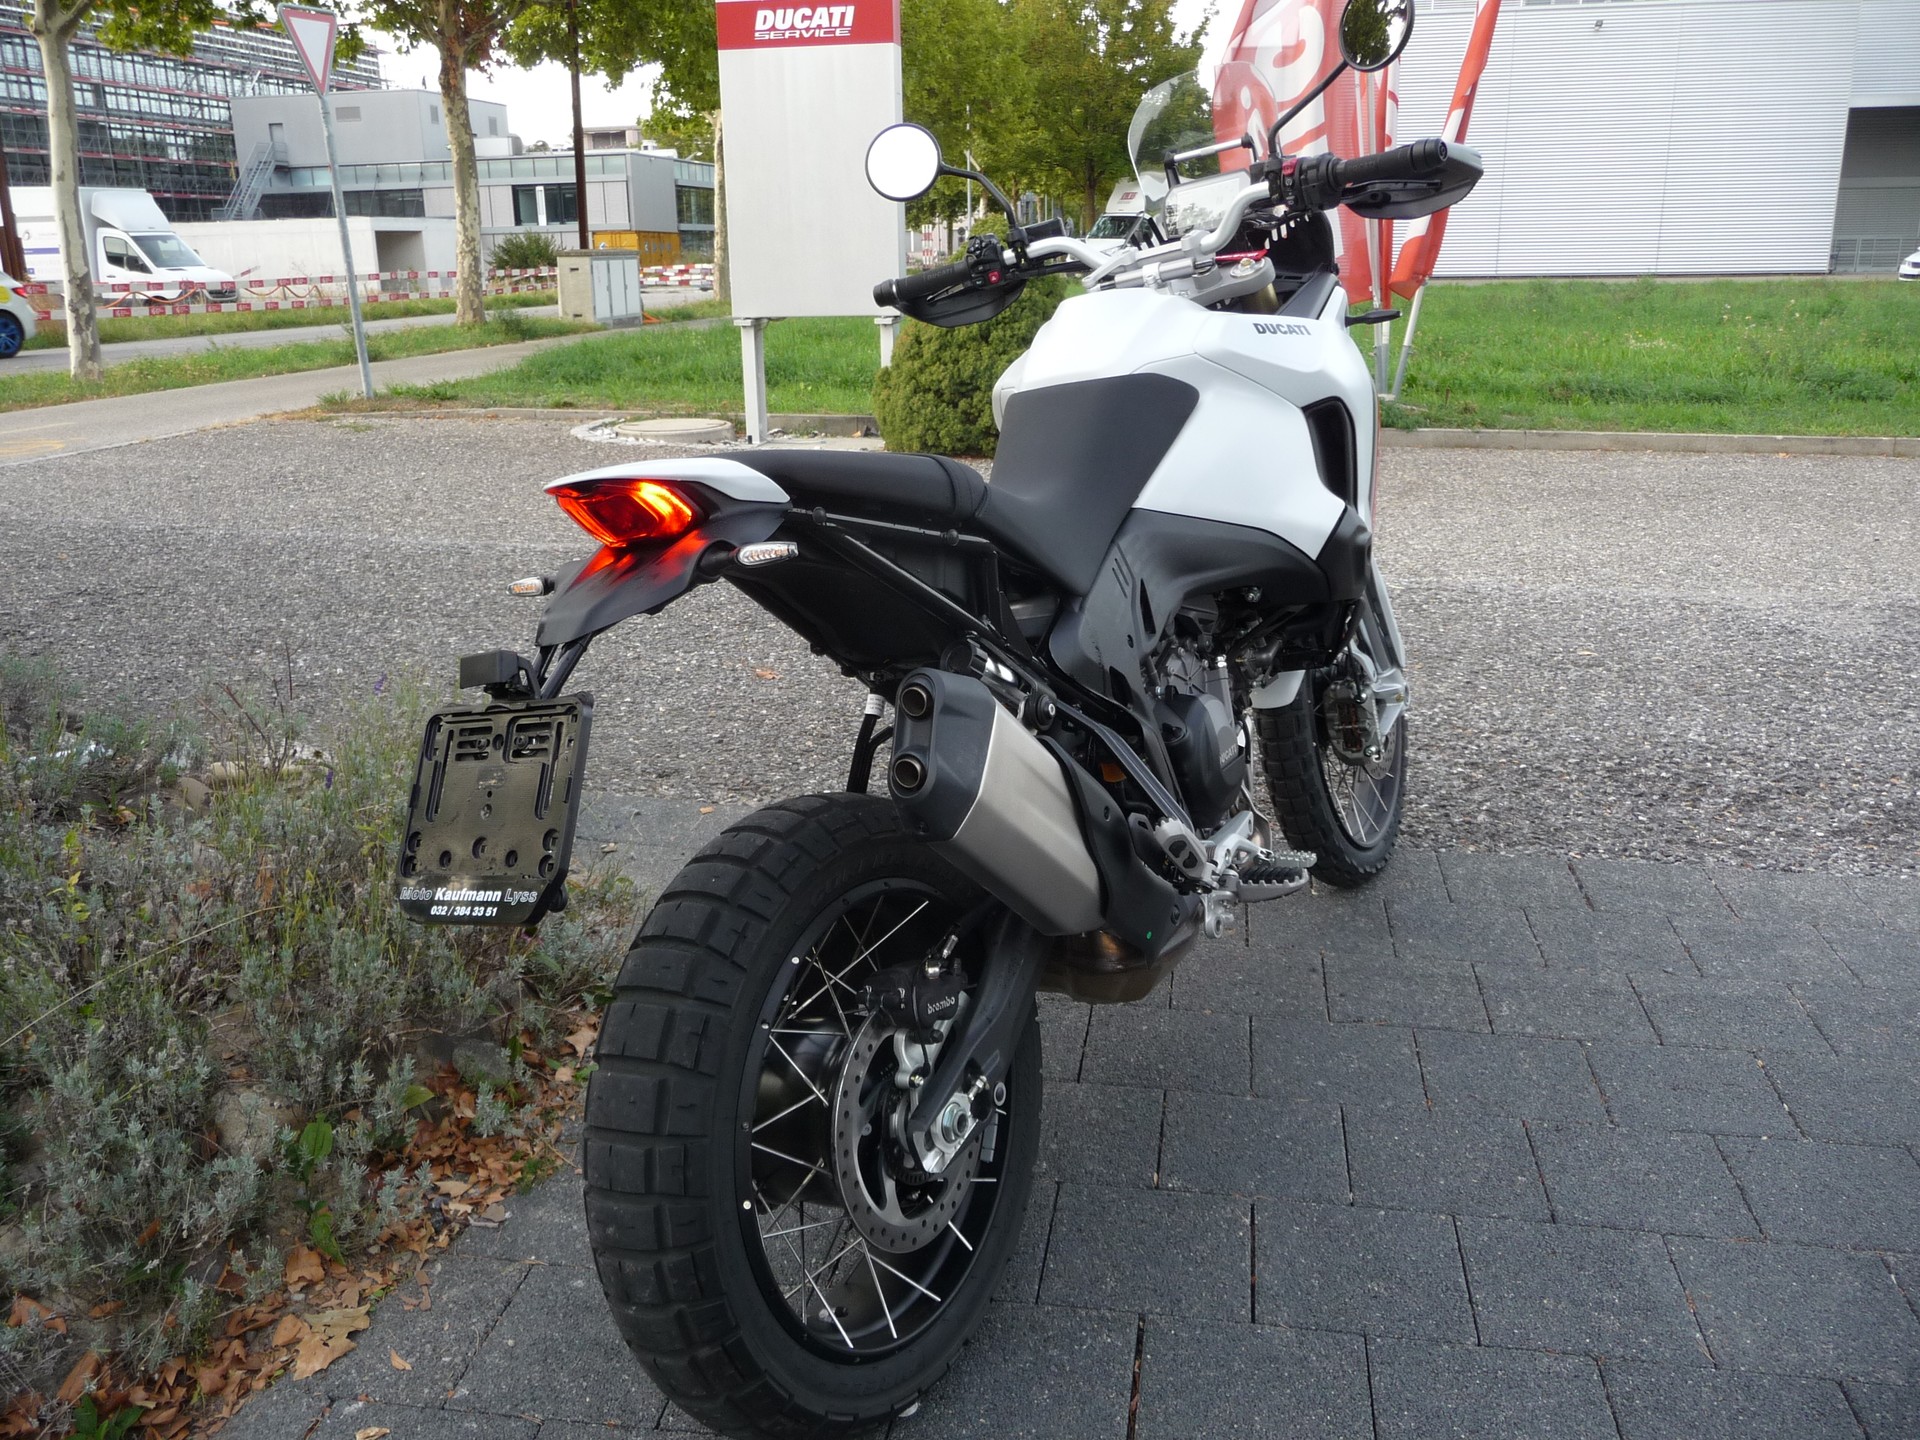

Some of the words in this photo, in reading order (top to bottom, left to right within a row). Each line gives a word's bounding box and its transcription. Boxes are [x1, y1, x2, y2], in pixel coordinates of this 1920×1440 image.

[755, 6, 855, 30] DUCATI
[754, 27, 852, 40] SERVICE
[1253, 323, 1312, 335] DUCATI
[400, 887, 432, 900] Moto
[434, 888, 502, 902] Kaufmann
[504, 888, 538, 905] Lyss
[430, 906, 447, 915] 032
[454, 906, 471, 916] 384
[472, 907, 485, 916] 33
[485, 907, 498, 917] 51
